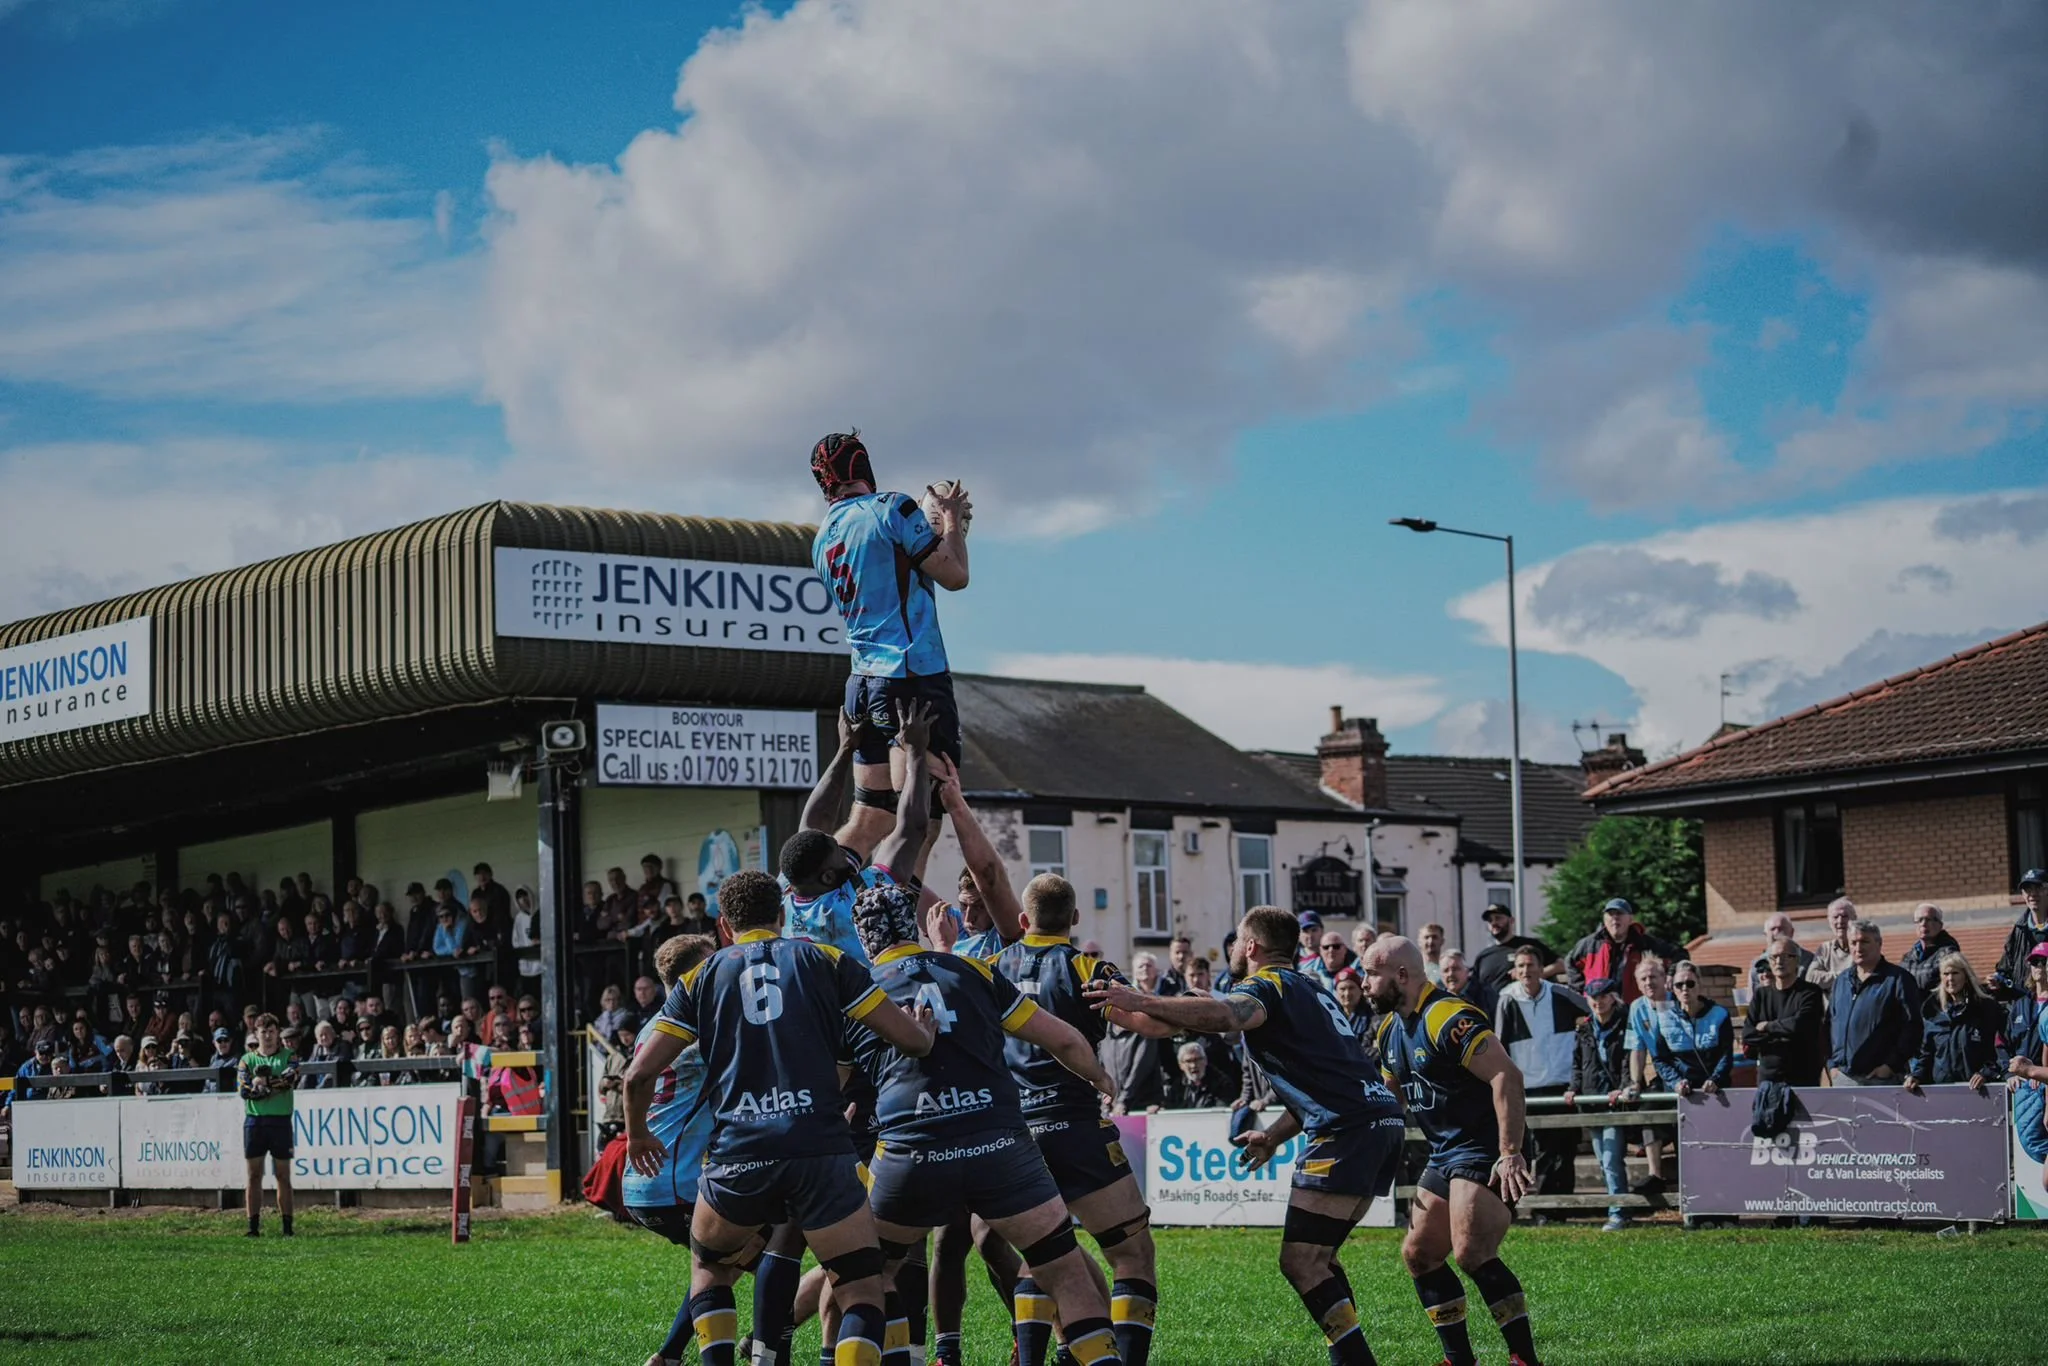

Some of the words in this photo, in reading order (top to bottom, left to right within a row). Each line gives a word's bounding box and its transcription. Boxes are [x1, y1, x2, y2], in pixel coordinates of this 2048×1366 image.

[592, 562, 834, 616] JENKINSO
[596, 612, 840, 645] insuranc
[7, 684, 128, 725] nsurance
[602, 728, 685, 749] SPECIAL
[691, 731, 756, 751] EVENT
[761, 734, 811, 753] HERE
[602, 752, 641, 780] Call
[745, 757, 813, 784] 512170
[739, 962, 784, 1026] 6
[913, 982, 958, 1033] 4
[1316, 992, 1355, 1036] 8
[733, 1086, 814, 1116] Atlas
[914, 1086, 994, 1116] Atlas
[293, 1104, 443, 1147] NKINSON
[26, 1146, 105, 1169] JENKINSON
[137, 1140, 221, 1163] JENKINSON
[927, 1136, 1016, 1163] RobinsonsGas
[1159, 1135, 1306, 1182] SteeP
[1750, 1132, 1818, 1166] B&B
[1816, 1153, 1856, 1166] VEHICLE
[1857, 1153, 1917, 1166] CONTRACTS
[27, 1171, 106, 1183] insurance
[294, 1156, 444, 1176] surance
[1807, 1168, 1825, 1180] Car
[1826, 1168, 1834, 1179] &
[1835, 1168, 1854, 1180] Van
[1855, 1168, 1892, 1183] Leasing
[1894, 1168, 1945, 1182] Specialists
[1159, 1188, 1201, 1204] Making
[1204, 1188, 1239, 1202] Roads
[1242, 1188, 1274, 1202] Safer
[1744, 1198, 1937, 1214] www.bandbvehiclecontracts.com
